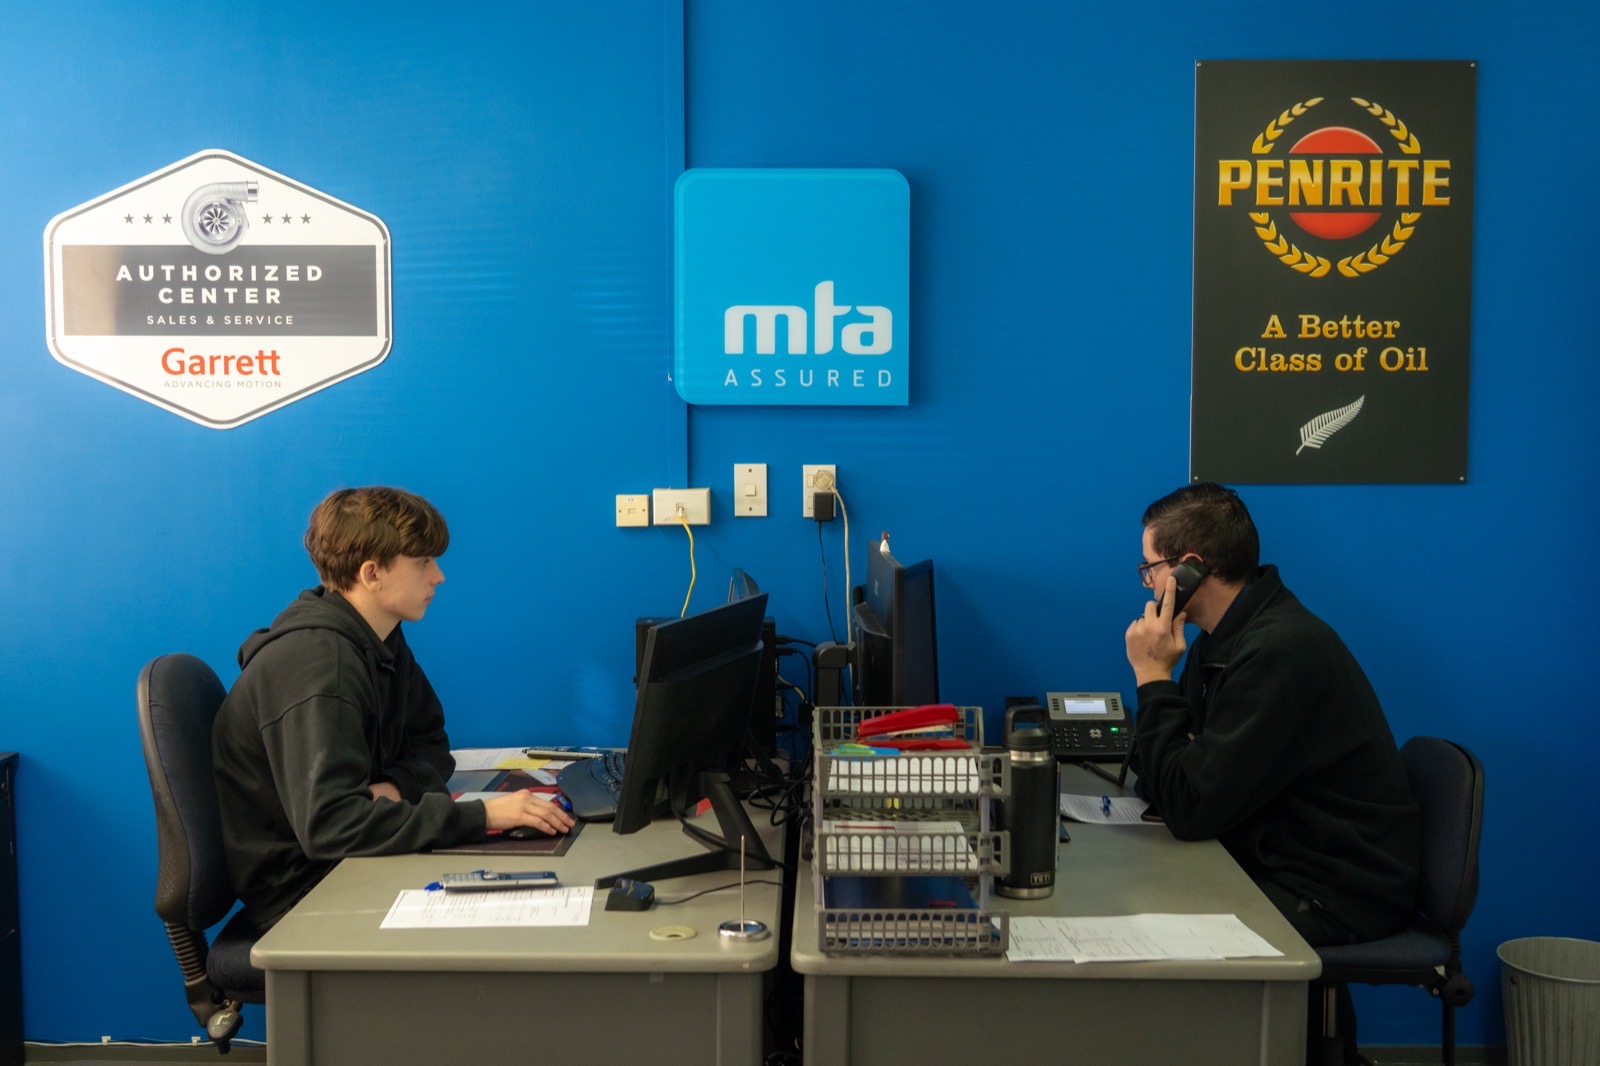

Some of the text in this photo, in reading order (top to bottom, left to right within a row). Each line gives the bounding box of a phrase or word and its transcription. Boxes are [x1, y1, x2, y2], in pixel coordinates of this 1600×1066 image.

[1217, 159, 1451, 206] PENRITE
[116, 264, 323, 282] AUTHORIZED
[158, 287, 281, 304] CENTER
[146, 315, 294, 325] SALES & SERVICE
[724, 280, 893, 355] mta
[1261, 314, 1401, 339] A Better
[161, 347, 280, 377] Garrett
[1235, 346, 1429, 372] Class of Oil
[163, 380, 282, 388] ADVANCING MOTION
[724, 369, 892, 387] ASSURED
